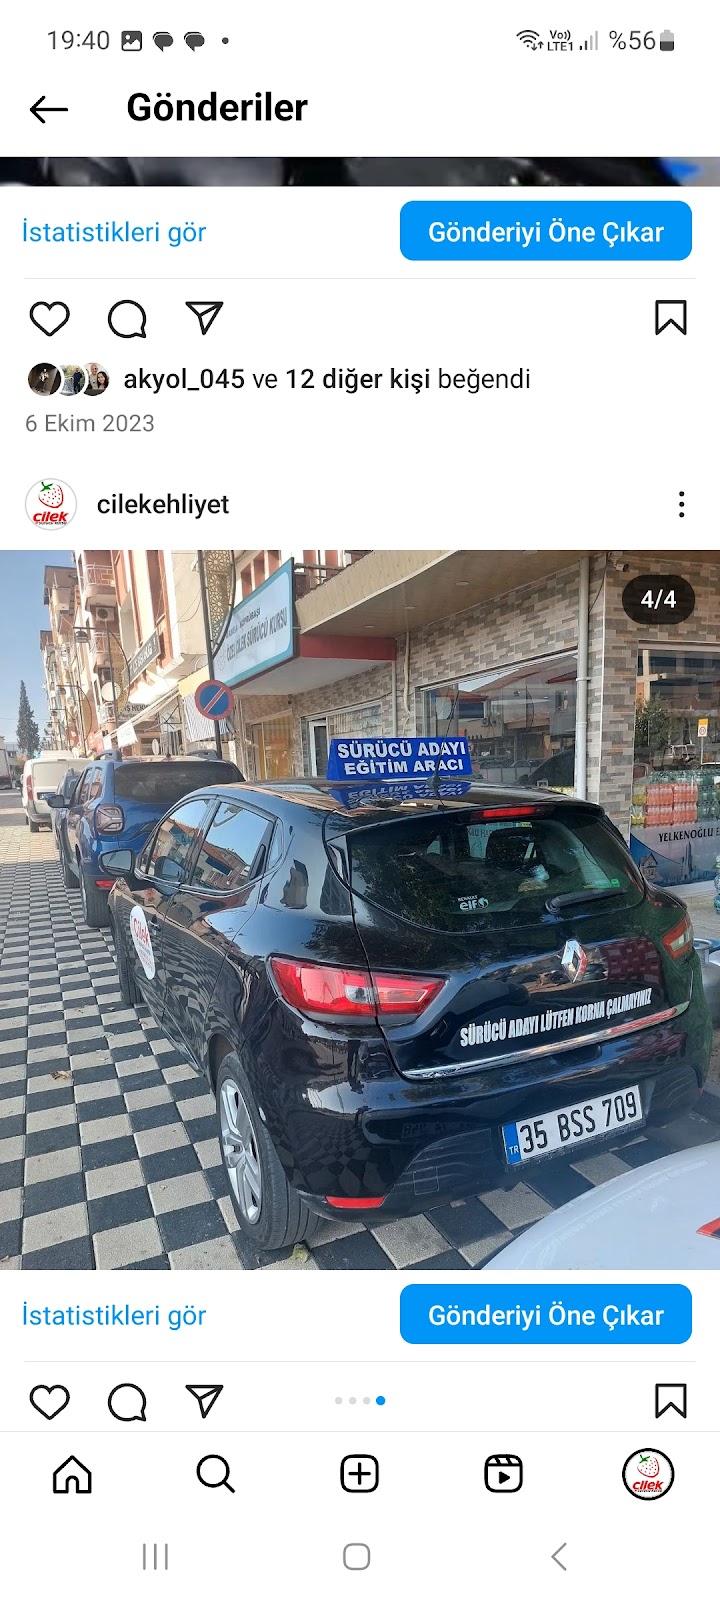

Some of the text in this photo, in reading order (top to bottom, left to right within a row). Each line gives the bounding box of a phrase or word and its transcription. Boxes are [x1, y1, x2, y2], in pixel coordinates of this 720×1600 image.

[48, 31, 110, 50] 19:40
[547, 42, 573, 51] LTE1
[608, 31, 656, 50] %56
[127, 91, 308, 121] Gönderiler
[22, 218, 207, 248] İstatistikleri gör
[429, 218, 665, 249] Gönderiyi Öne Çıkar
[123, 368, 530, 395] akyol_045 ve 12 diğer kişi beğendi
[25, 414, 155, 432] 6 Ekim 2023
[97, 493, 230, 520] cilekehliyet
[337, 740, 466, 759] SÜRÜCÜ ADAYI
[344, 758, 464, 775] EĞİTİM ARACI
[658, 827, 714, 843] YELKENOĞLU
[459, 900, 478, 911] elf
[460, 988, 652, 1048] SÜRÜCÜ ADAYI LÜTFEN KORNA ÇALMAYINIZ
[519, 1091, 637, 1153] 35 BSS 709
[509, 1146, 519, 1155] TR
[22, 1301, 207, 1331] İstatistikleri gör
[429, 1301, 665, 1332] Gönderiyi Öne Çıkar
